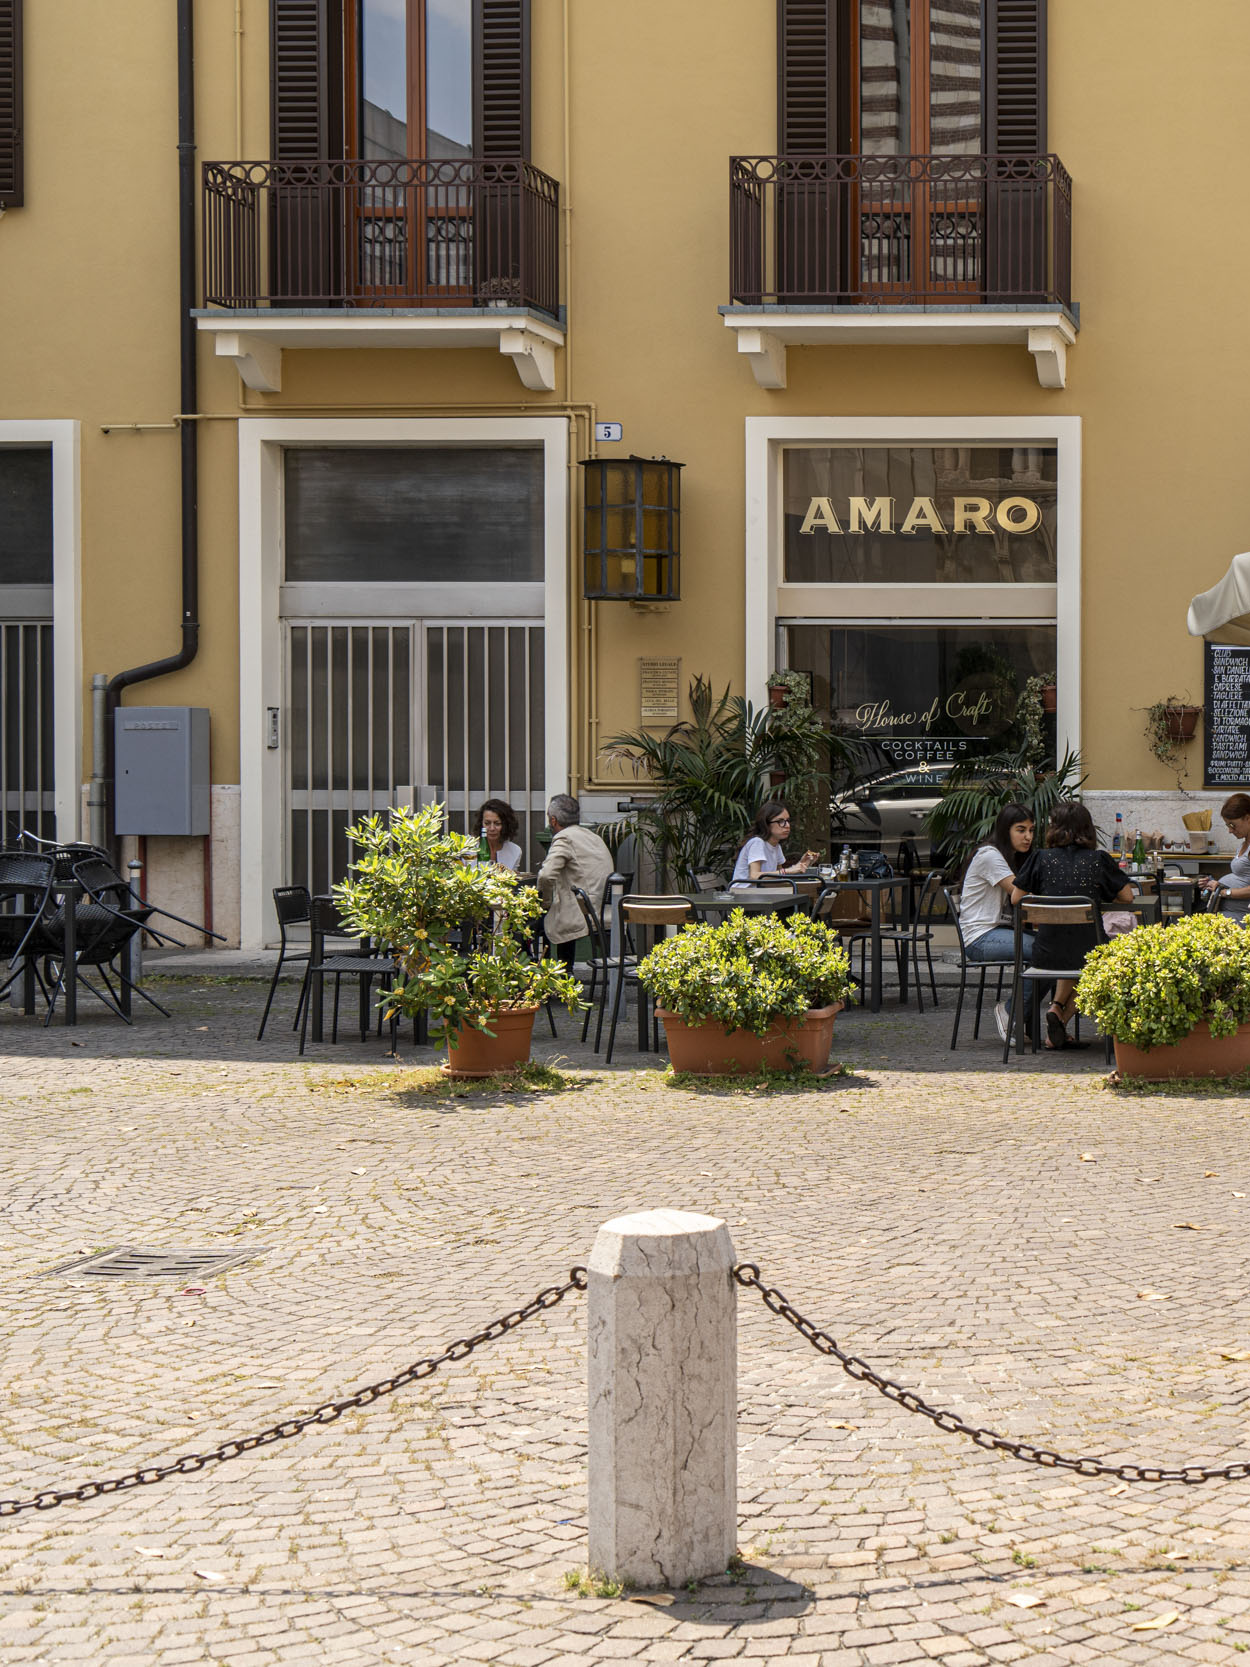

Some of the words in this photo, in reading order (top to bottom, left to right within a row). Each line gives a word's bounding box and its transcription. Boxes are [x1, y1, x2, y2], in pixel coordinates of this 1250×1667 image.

[604, 426, 611, 438] 5
[799, 496, 1042, 534] AMARO
[1222, 675, 1250, 683] BURRATA
[1213, 683, 1243, 691] CAPRESE
[1213, 692, 1243, 700] TAGLIERE
[855, 699, 917, 730] House
[918, 696, 940, 731] of
[945, 690, 993, 725] Craft
[1213, 708, 1248, 716] SELEZIONE
[881, 741, 967, 750] COCKTAILS
[894, 751, 954, 760] COFFEE
[918, 761, 930, 773] &
[905, 774, 943, 783] WINE
